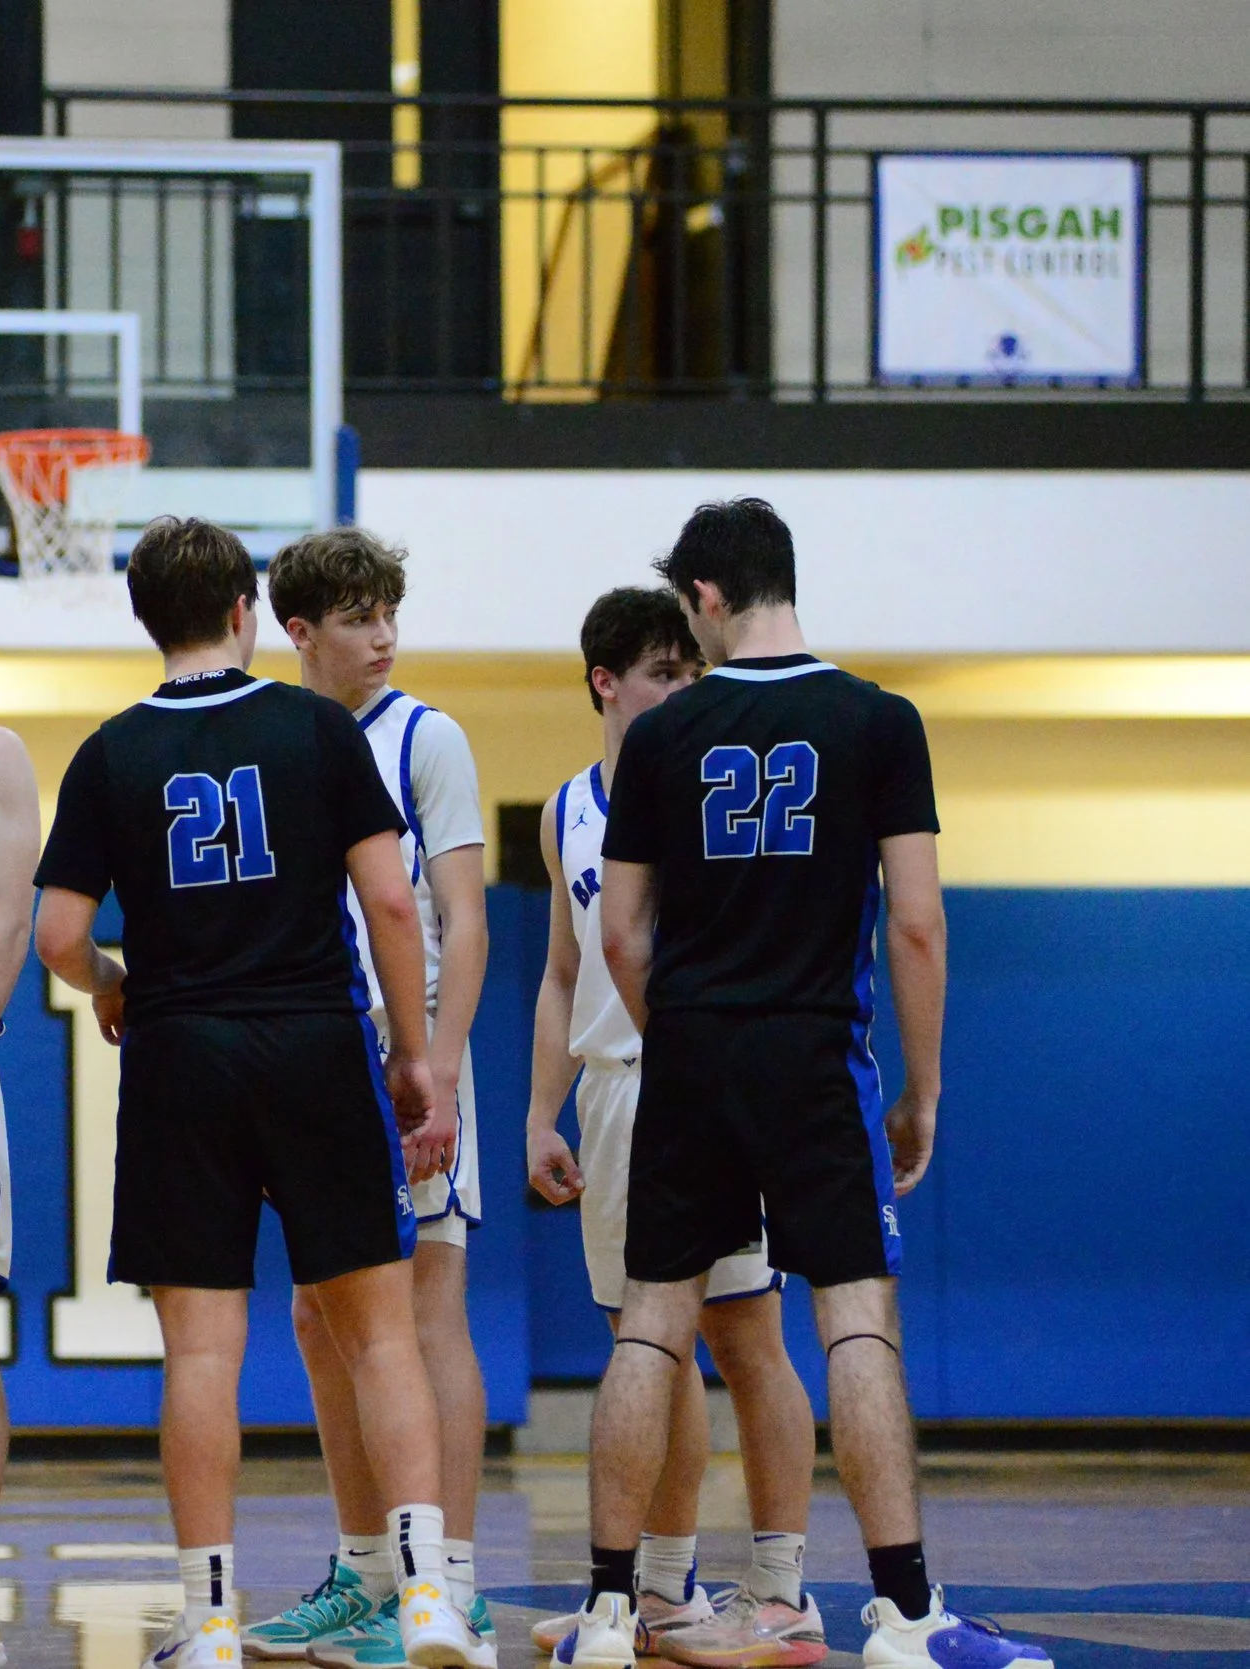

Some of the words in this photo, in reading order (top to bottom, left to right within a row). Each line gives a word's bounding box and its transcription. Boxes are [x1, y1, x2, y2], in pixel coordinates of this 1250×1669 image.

[936, 205, 1121, 241] PISGAH
[175, 673, 201, 686] NIKE
[202, 669, 226, 680] PRO
[163, 764, 277, 889] 21
[700, 741, 819, 860] 22
